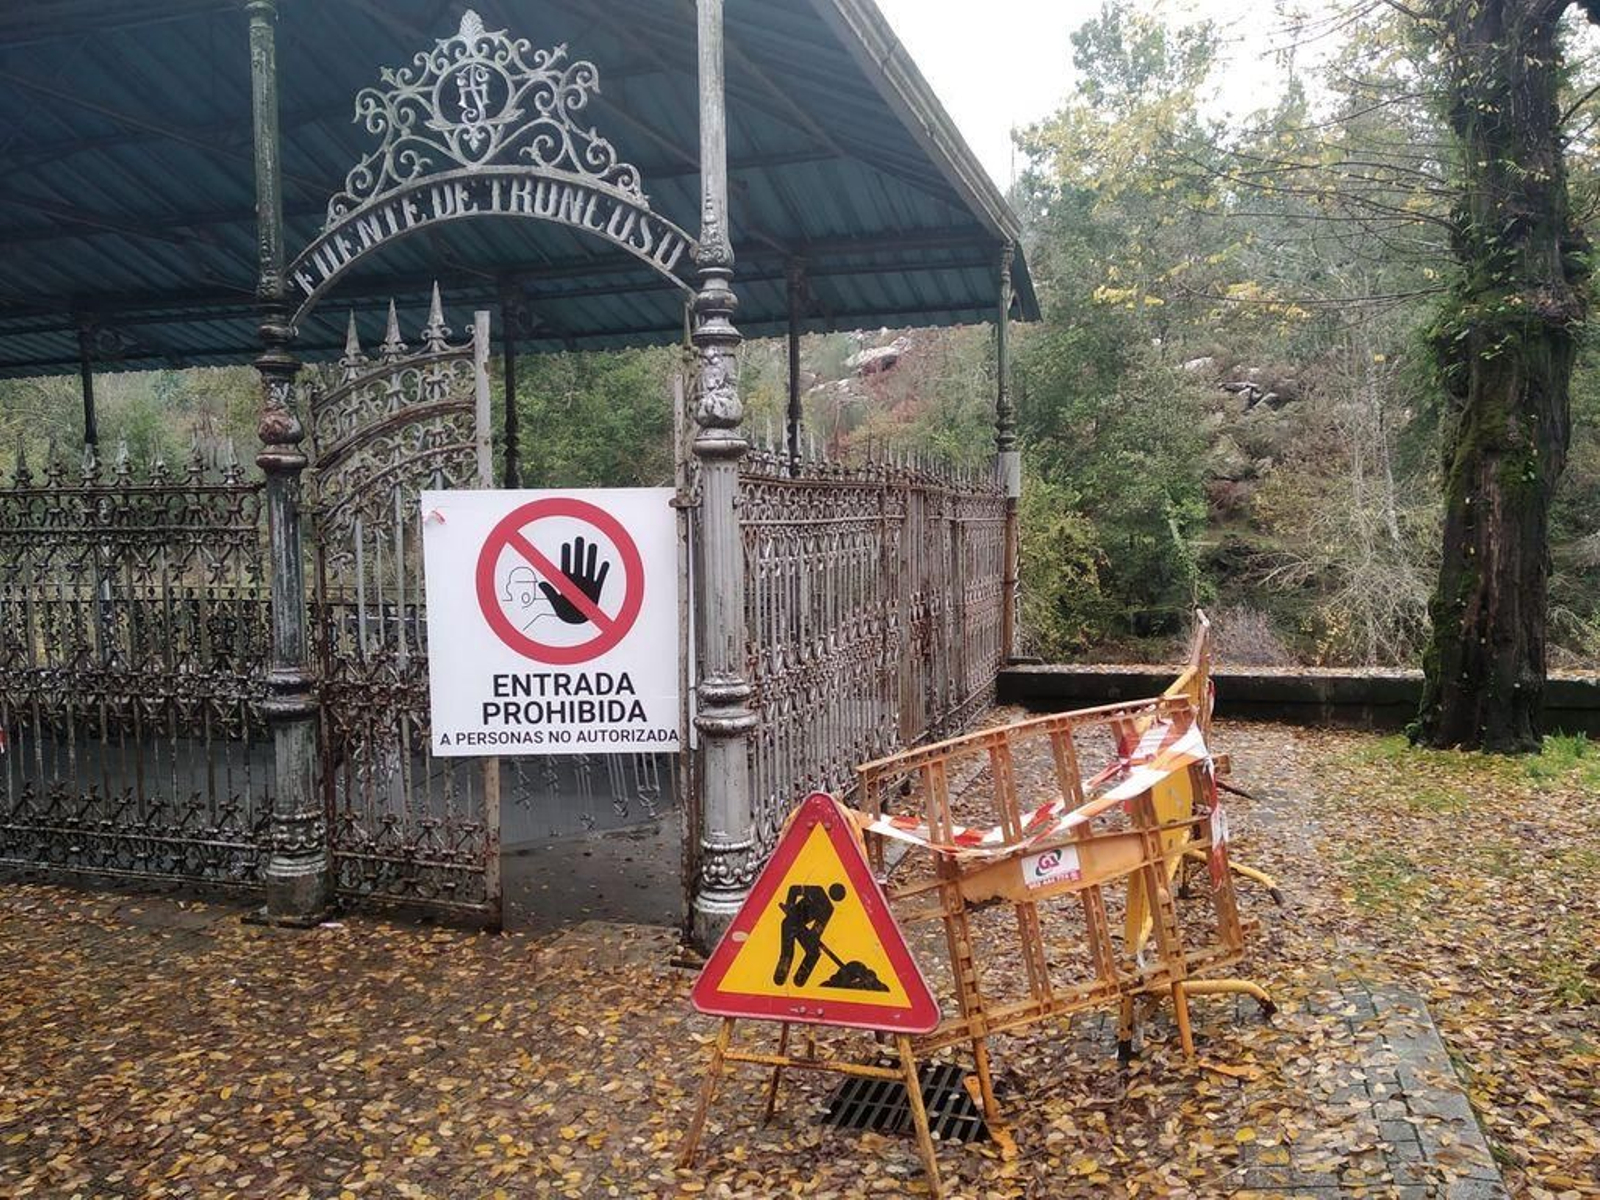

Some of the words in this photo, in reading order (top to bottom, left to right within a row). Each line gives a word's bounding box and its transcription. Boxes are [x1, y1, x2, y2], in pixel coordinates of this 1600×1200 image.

[286, 190, 427, 297] FUENTE
[430, 179, 479, 219] DE
[493, 671, 636, 698] ENTRADA
[482, 699, 648, 725] PROHIBIDA
[440, 732, 451, 746] A
[456, 730, 544, 746] PERSONAS
[549, 729, 572, 743] NO
[576, 728, 679, 743] AUTORIZADA
